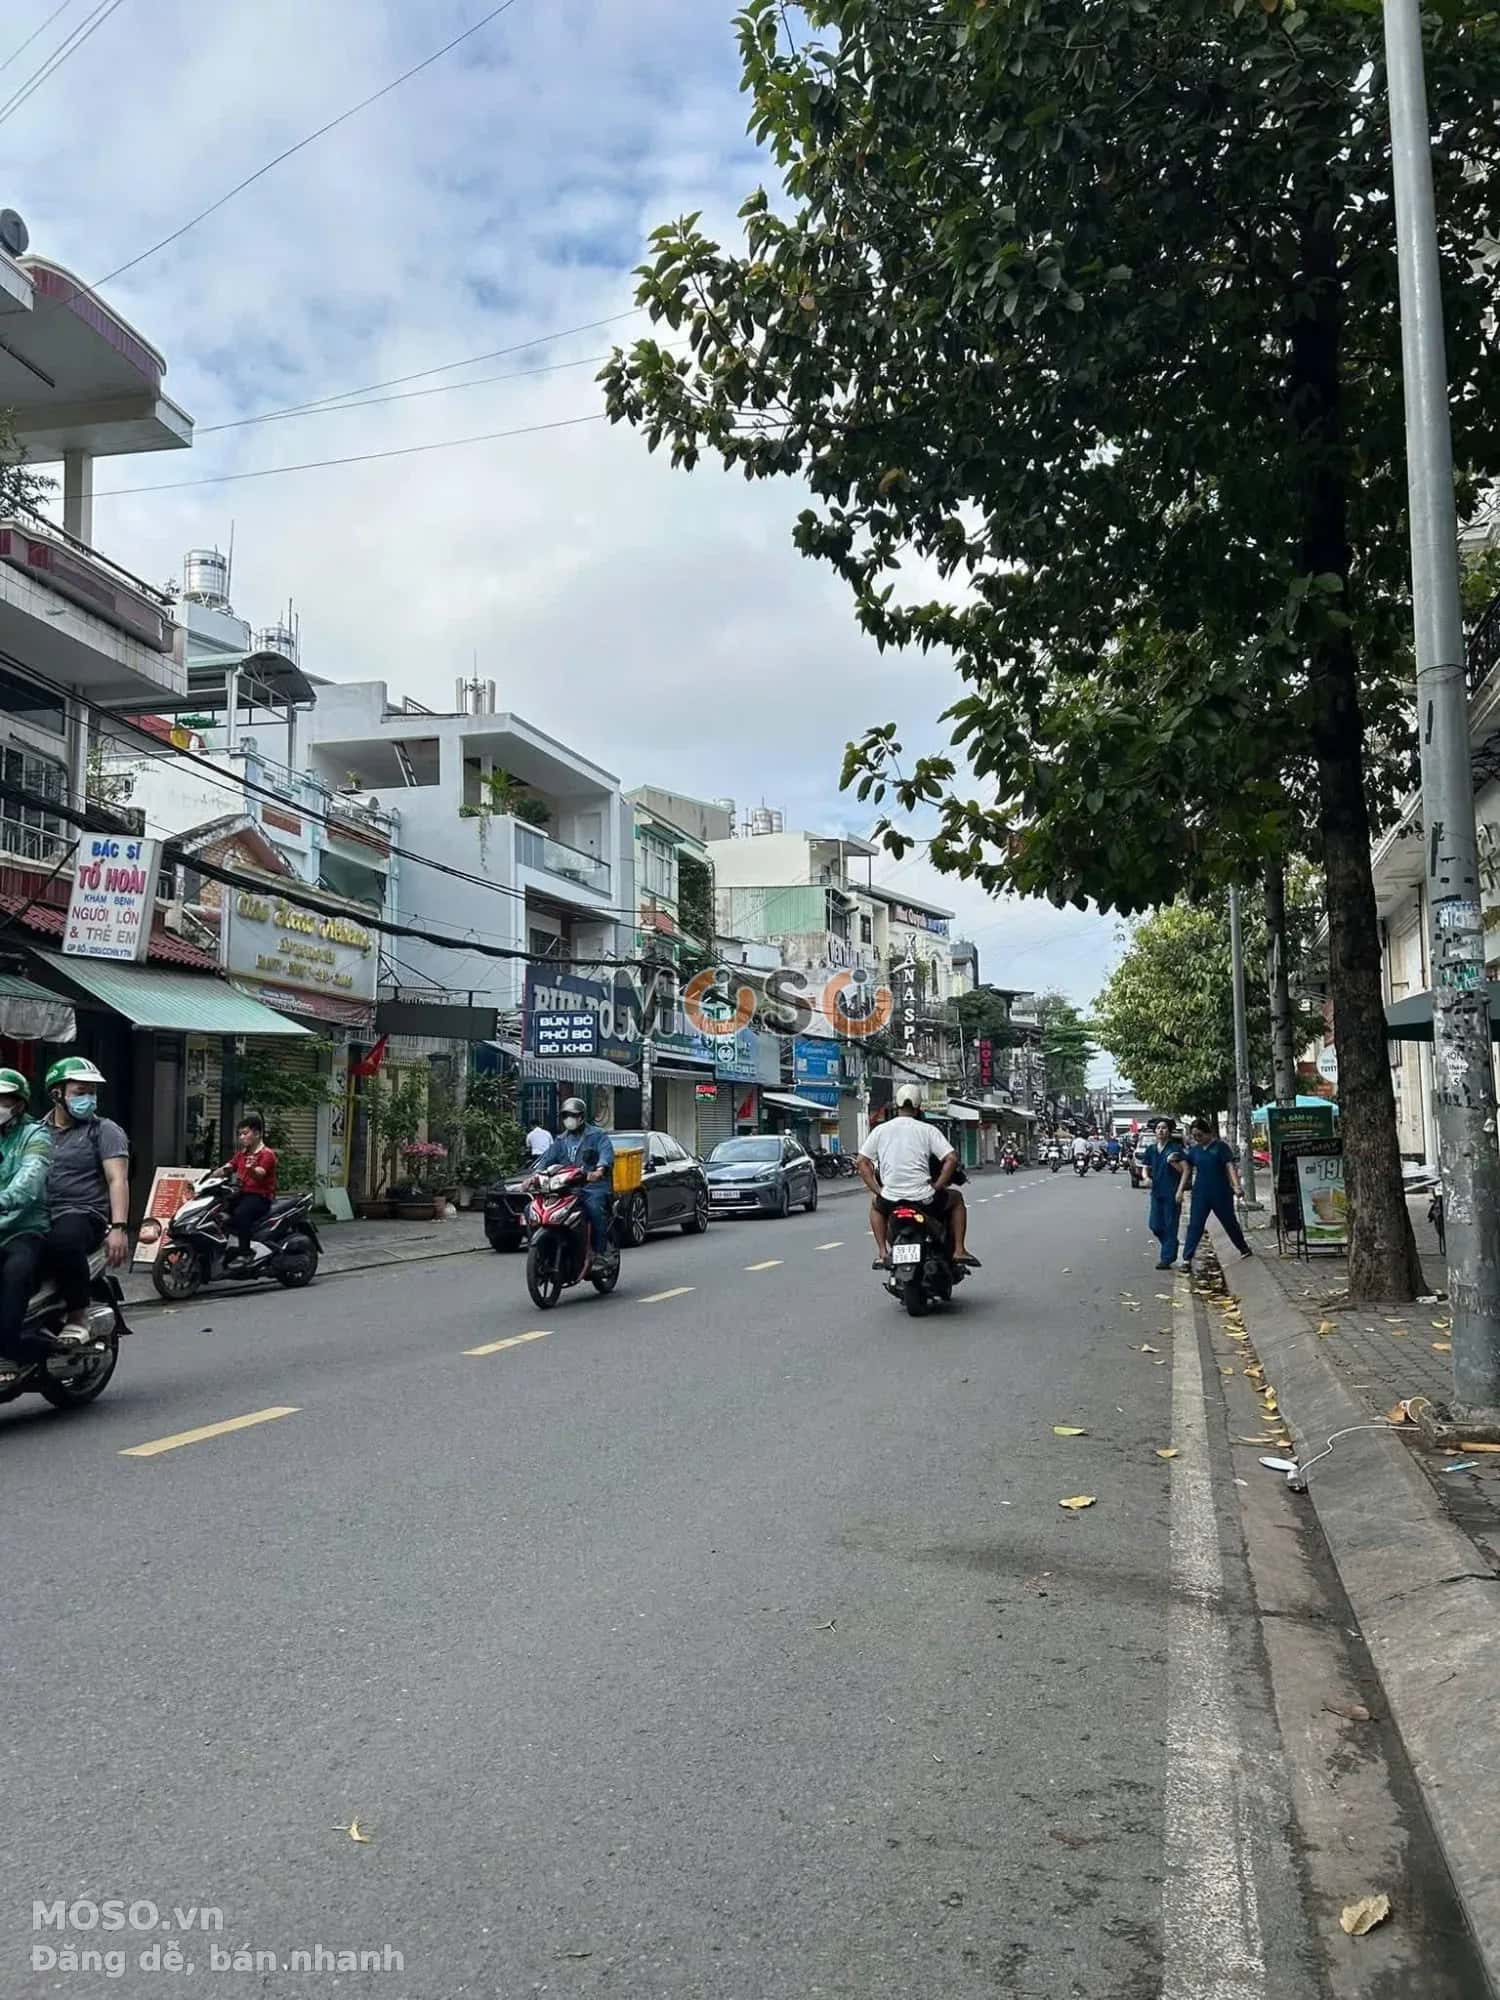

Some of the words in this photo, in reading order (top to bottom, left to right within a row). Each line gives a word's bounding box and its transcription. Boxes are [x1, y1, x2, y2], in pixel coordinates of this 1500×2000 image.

[92, 839, 119, 858] BÁC
[79, 858, 105, 890] TỐ
[105, 864, 147, 894] HOÀI
[72, 905, 109, 922] NGƯỜI
[117, 907, 140, 926] LỚN
[70, 926, 79, 939] &
[86, 924, 112, 942] TRẺ
[117, 930, 137, 945] EM
[540, 1015, 569, 1026] BÚN
[573, 1014, 593, 1026] BÒ
[540, 1028, 568, 1040] PHỞ
[572, 1028, 592, 1039] BÒ
[540, 1042, 559, 1053] BÒ
[563, 1043, 593, 1053] KHO
